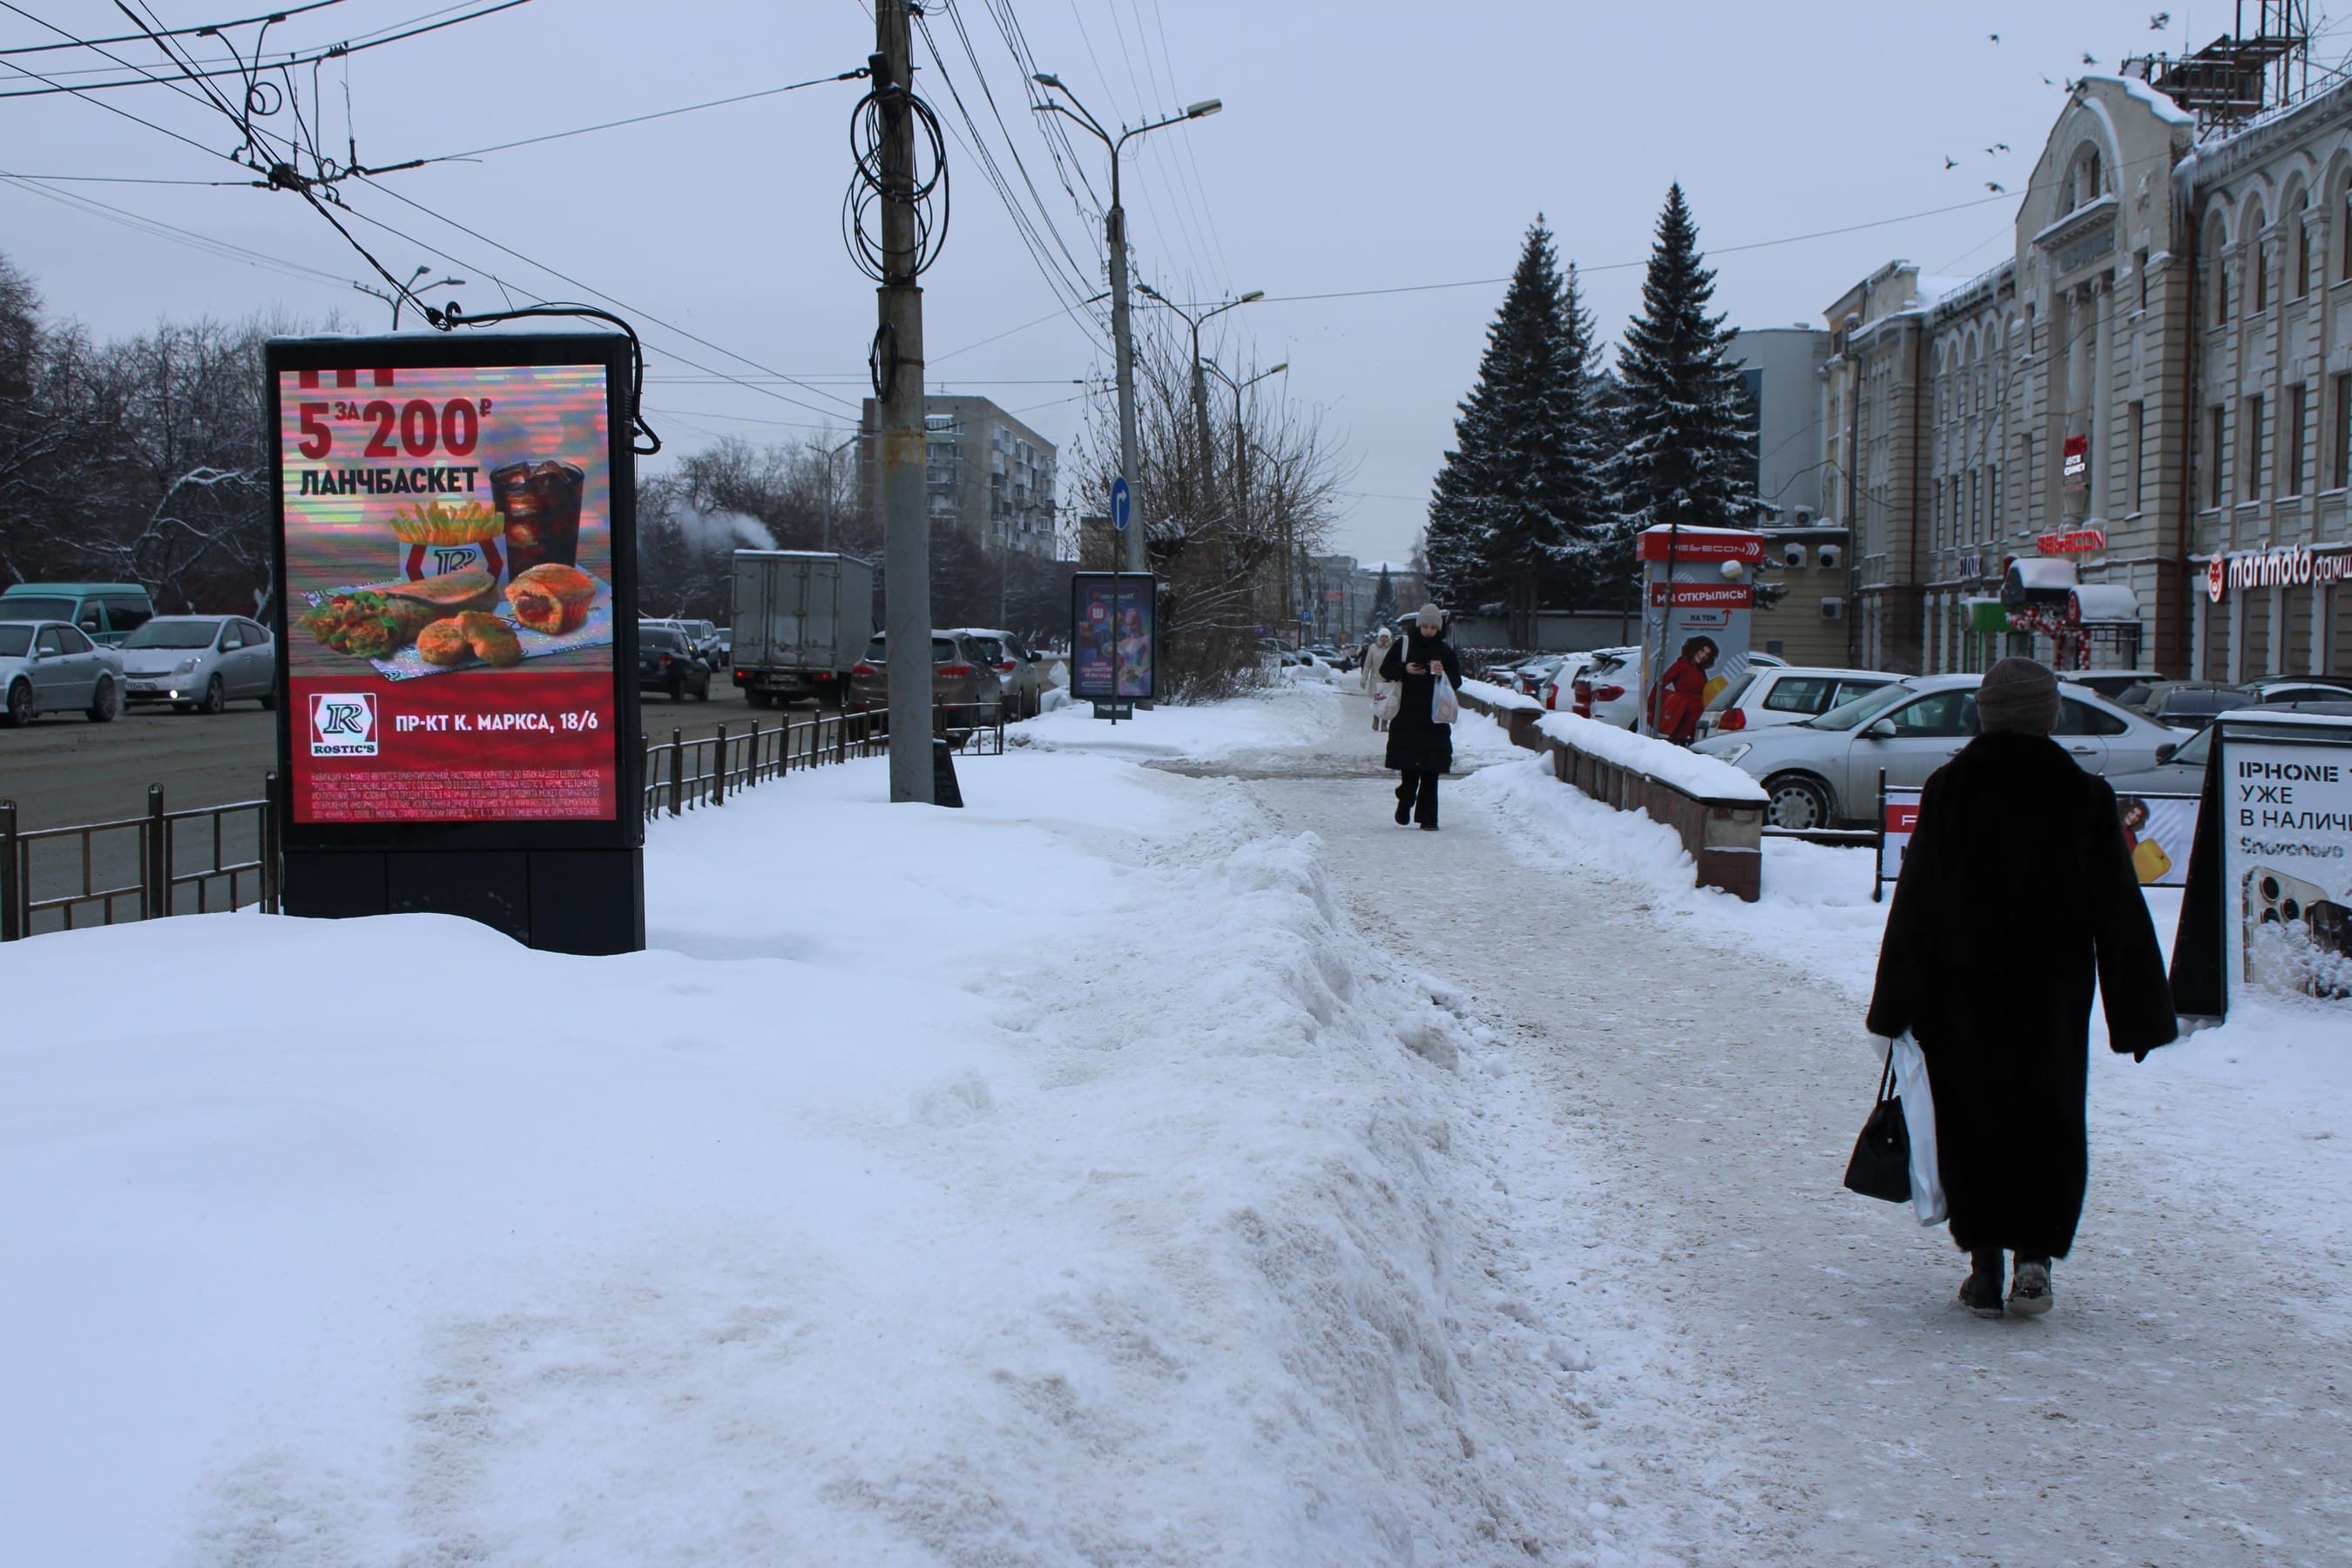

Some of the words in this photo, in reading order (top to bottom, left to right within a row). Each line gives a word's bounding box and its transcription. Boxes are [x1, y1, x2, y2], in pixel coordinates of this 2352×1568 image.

[298, 402, 333, 460] 5
[335, 401, 361, 422] ЗА
[300, 466, 479, 497] ЛАНЧБАСКЕТ
[2227, 541, 2313, 589] marimoto
[1678, 590, 1747, 603] ОТКРЫЛИСЬ!
[395, 713, 449, 733] ПР-КТ
[454, 713, 473, 732] К.
[477, 713, 556, 734] МАРКСА,
[559, 710, 598, 732] 18/6
[313, 745, 376, 754] ROSTIC'S
[2239, 760, 2340, 783] IPHONE
[2240, 784, 2293, 804] УЖЕ
[2240, 808, 2254, 827] В
